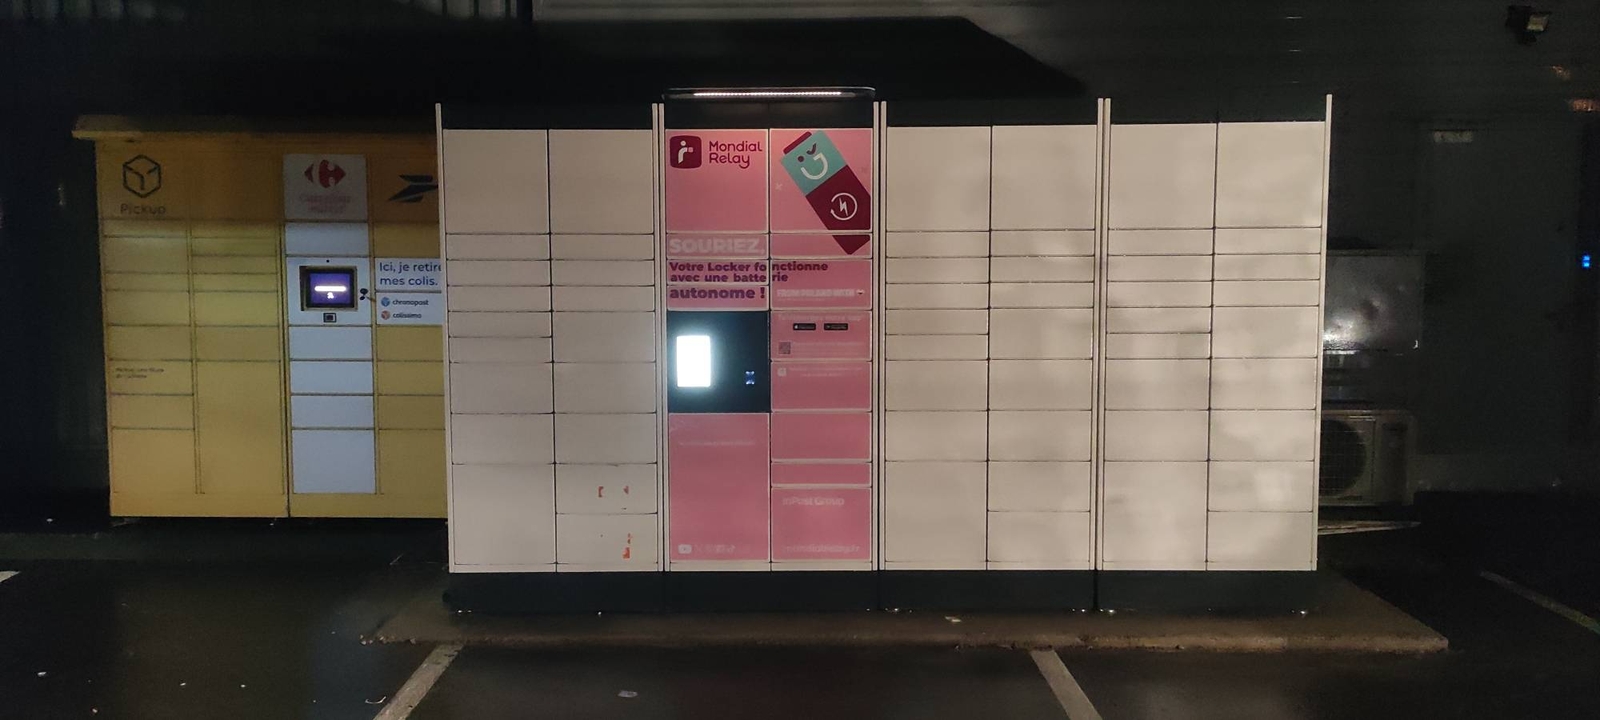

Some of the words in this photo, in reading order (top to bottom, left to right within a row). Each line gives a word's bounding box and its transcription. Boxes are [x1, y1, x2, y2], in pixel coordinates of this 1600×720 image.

[709, 140, 762, 152] Mondial
[709, 153, 750, 169] Relay
[669, 237, 765, 255] SOURIEZ,
[379, 261, 396, 272] Ici,
[398, 261, 410, 274] je
[670, 262, 703, 272] Votre
[707, 262, 751, 272] Locker
[379, 277, 405, 286] mes
[408, 276, 438, 286] colis.
[670, 273, 700, 283] avec
[704, 273, 728, 283] une
[669, 287, 756, 300] autonome
[760, 286, 766, 300] !
[392, 299, 429, 307] chronopost
